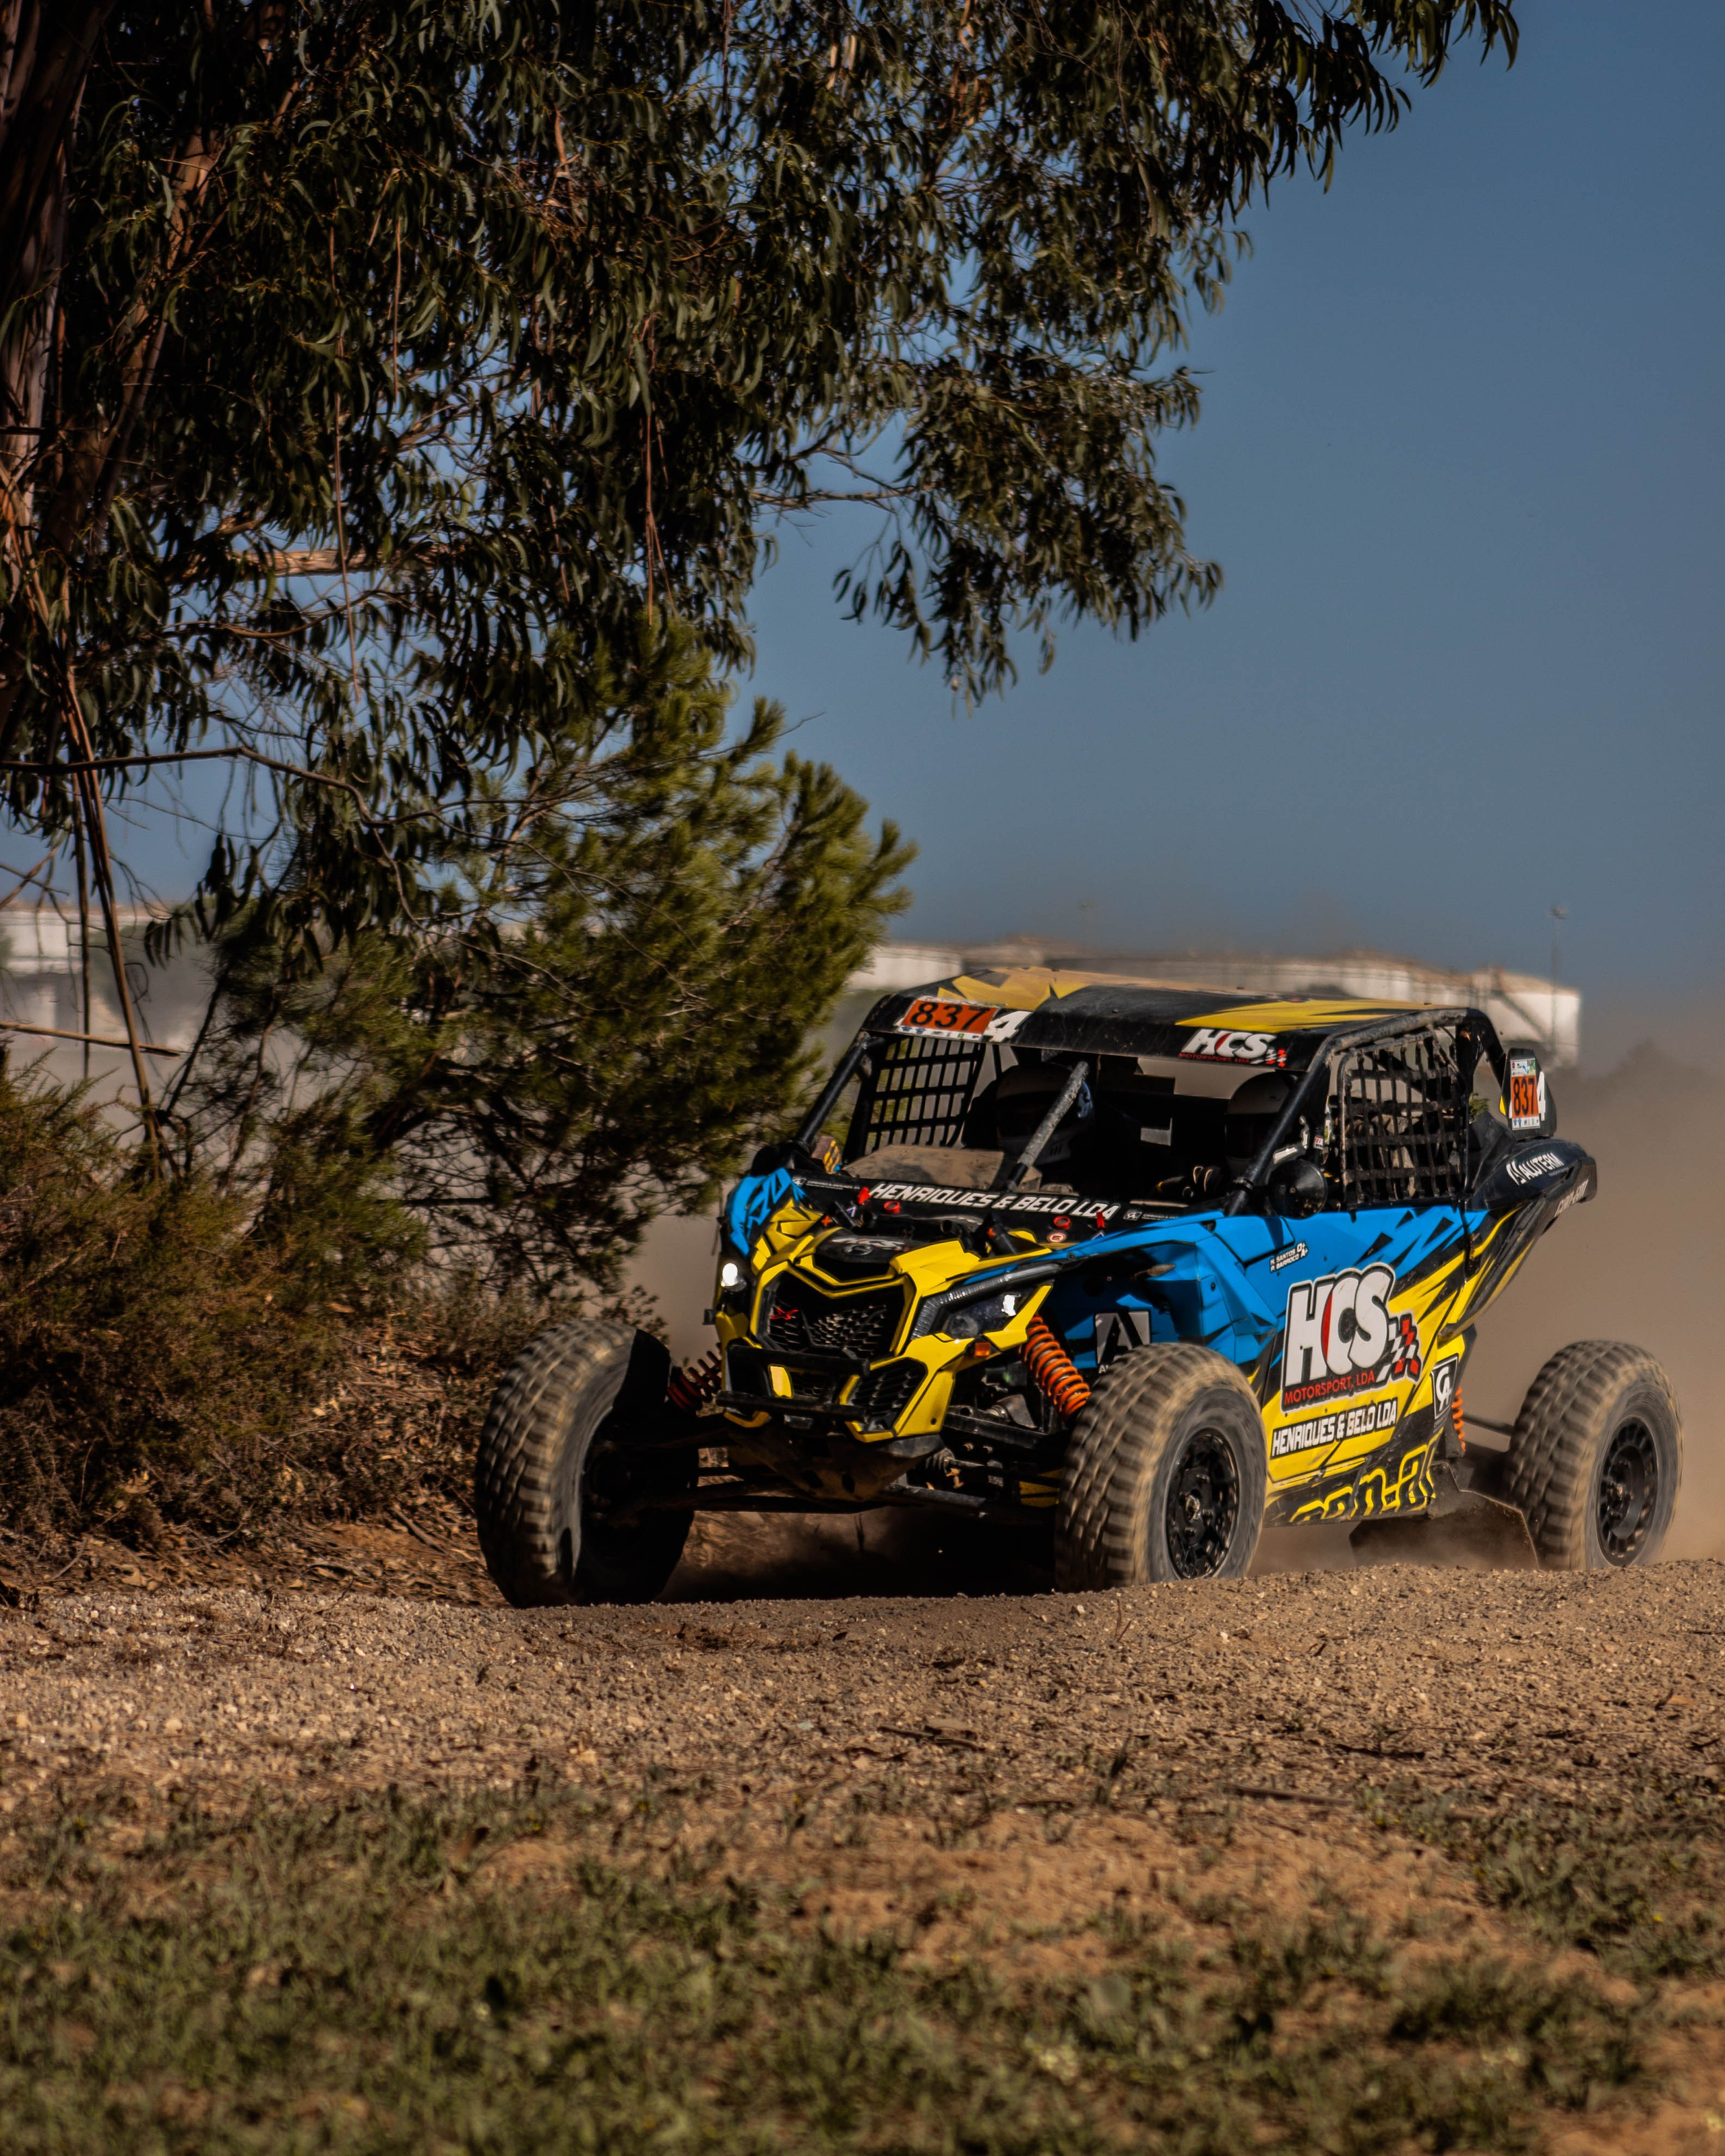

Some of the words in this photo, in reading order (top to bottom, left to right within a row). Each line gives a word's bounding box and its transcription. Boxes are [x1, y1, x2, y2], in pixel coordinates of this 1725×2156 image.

[910, 1002, 990, 1031] 837
[1181, 1028, 1277, 1059] HCS
[1513, 1078, 1535, 1116] 837
[871, 1183, 998, 1207] HENRIQUES
[992, 1195, 1016, 1209] &
[1011, 1196, 1077, 1213] BELO
[1070, 1201, 1120, 1219] LDA
[1276, 1248, 1296, 1263] SANTOS
[1284, 1271, 1391, 1387] HCS
[1284, 1376, 1354, 1405] MOTORSPORT,
[1356, 1370, 1375, 1386] LDA
[1272, 1416, 1336, 1457] HENRIQUES
[1337, 1412, 1346, 1438] &
[1347, 1404, 1376, 1436] BELO
[1377, 1401, 1398, 1424] LDA
